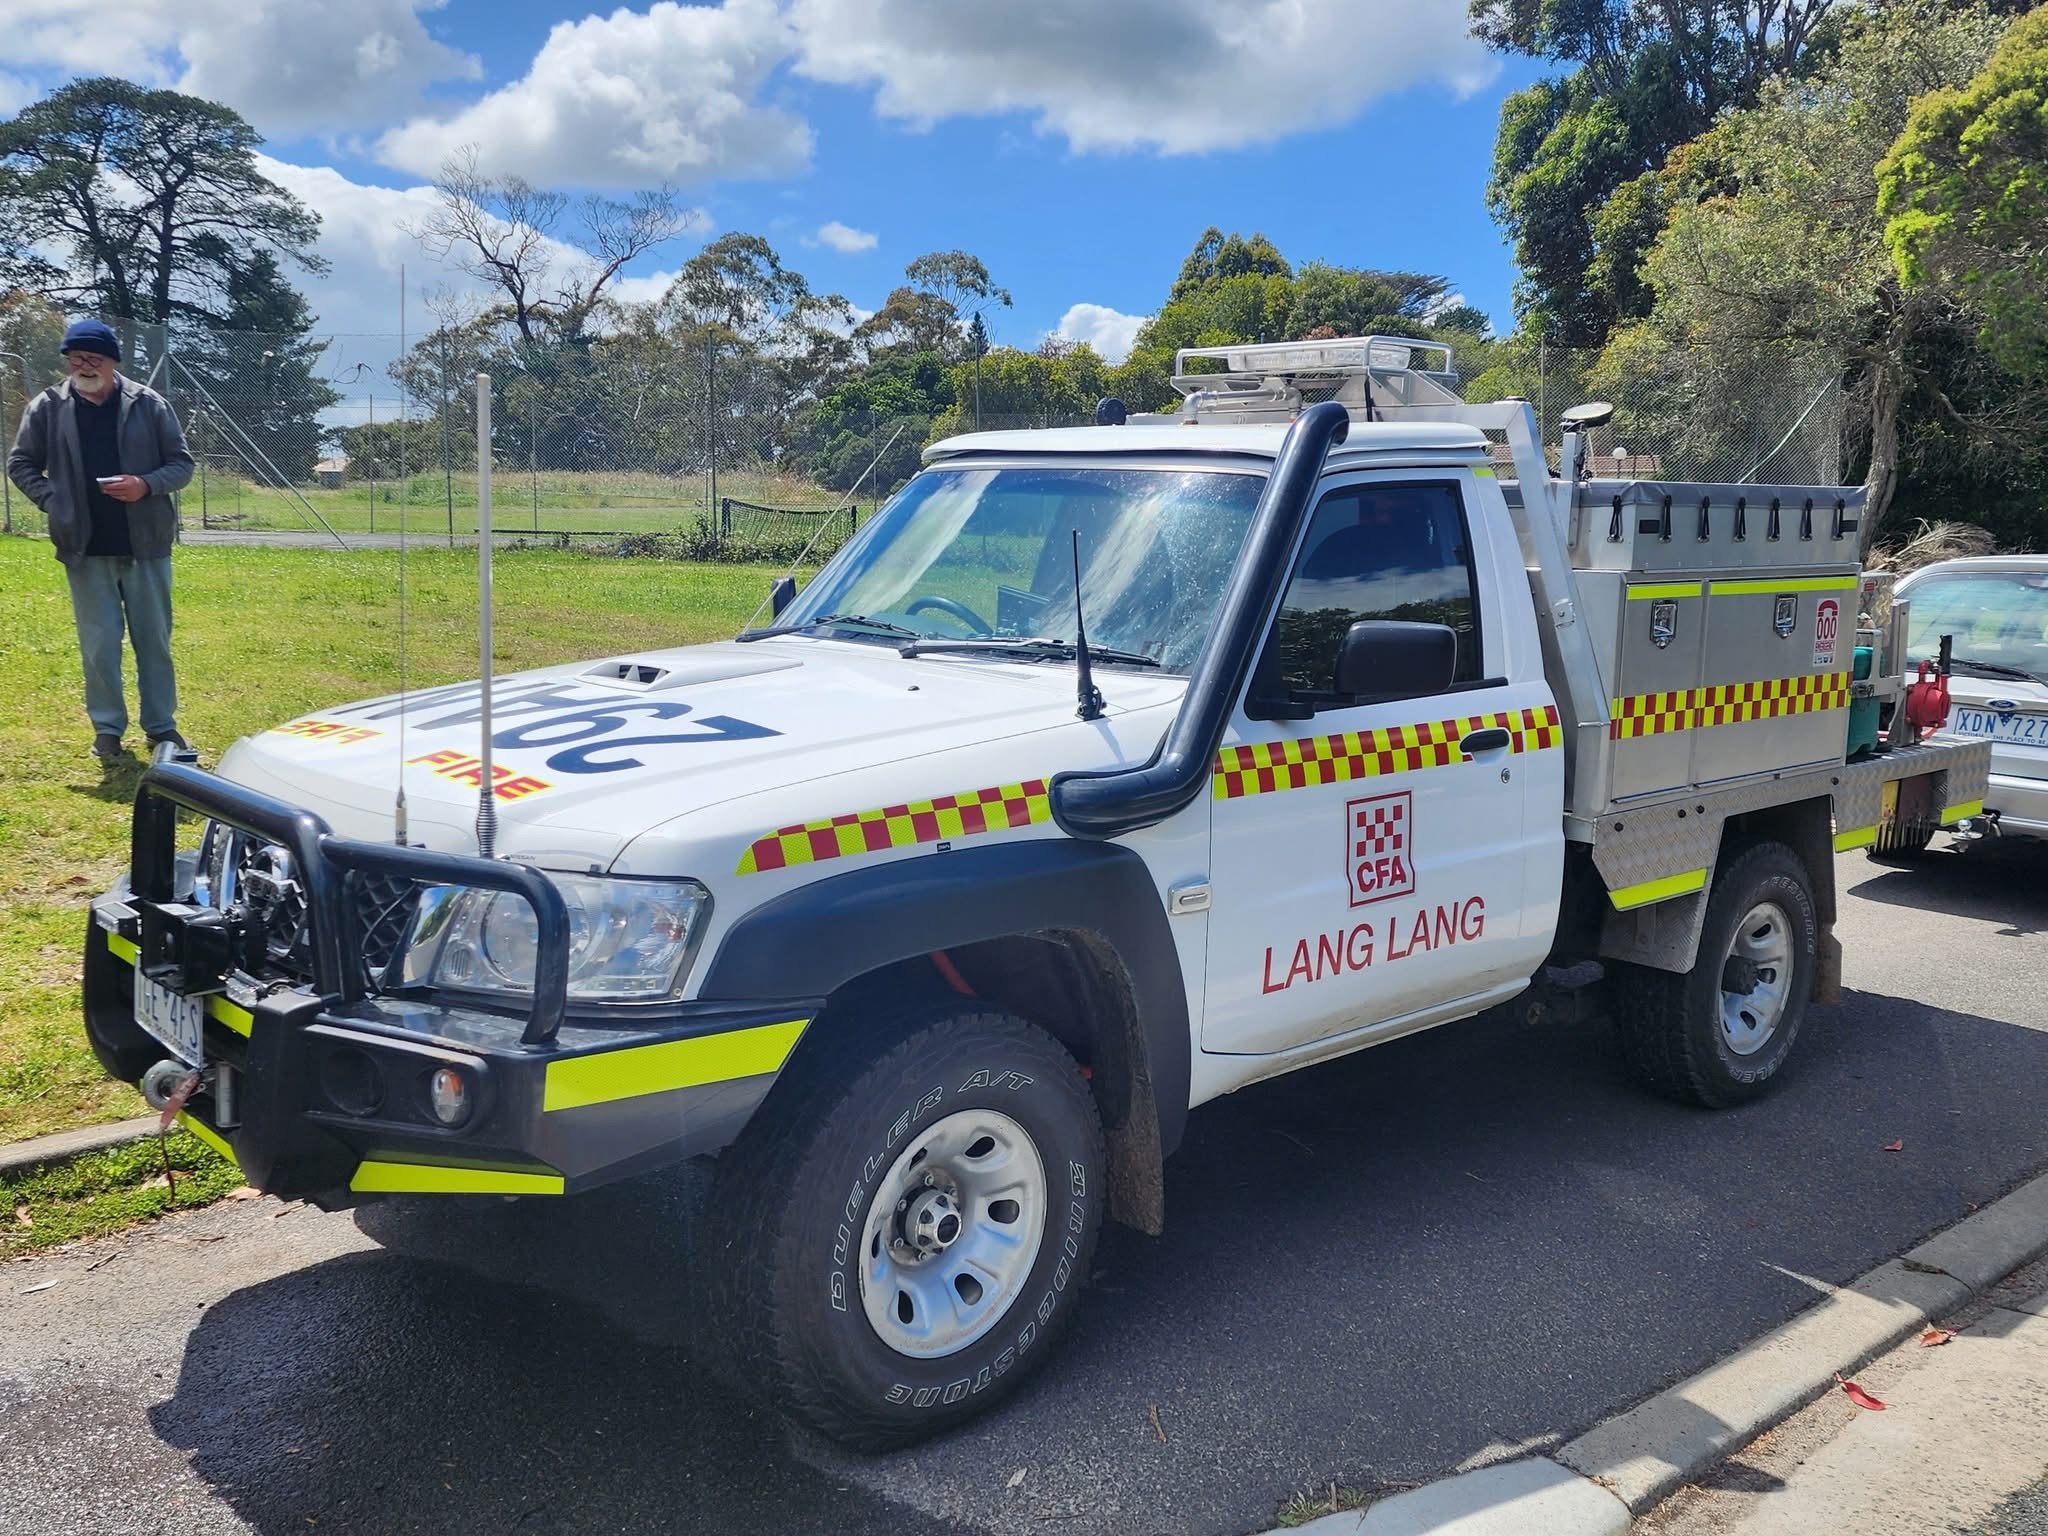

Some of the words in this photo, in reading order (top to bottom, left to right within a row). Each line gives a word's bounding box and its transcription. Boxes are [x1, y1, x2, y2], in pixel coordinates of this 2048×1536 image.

[1817, 617, 1837, 640] 000
[1958, 711, 1997, 734] XDN
[2012, 717, 2048, 739] 727
[404, 749, 553, 802] FIRE
[1356, 855, 1407, 894] CFA
[1262, 923, 1374, 995] LANG
[1386, 896, 1485, 962] LANG
[829, 1086, 944, 1312] DUELER
[956, 1069, 1035, 1093] A/T
[885, 1160, 1087, 1408] BRIDGESTONE
